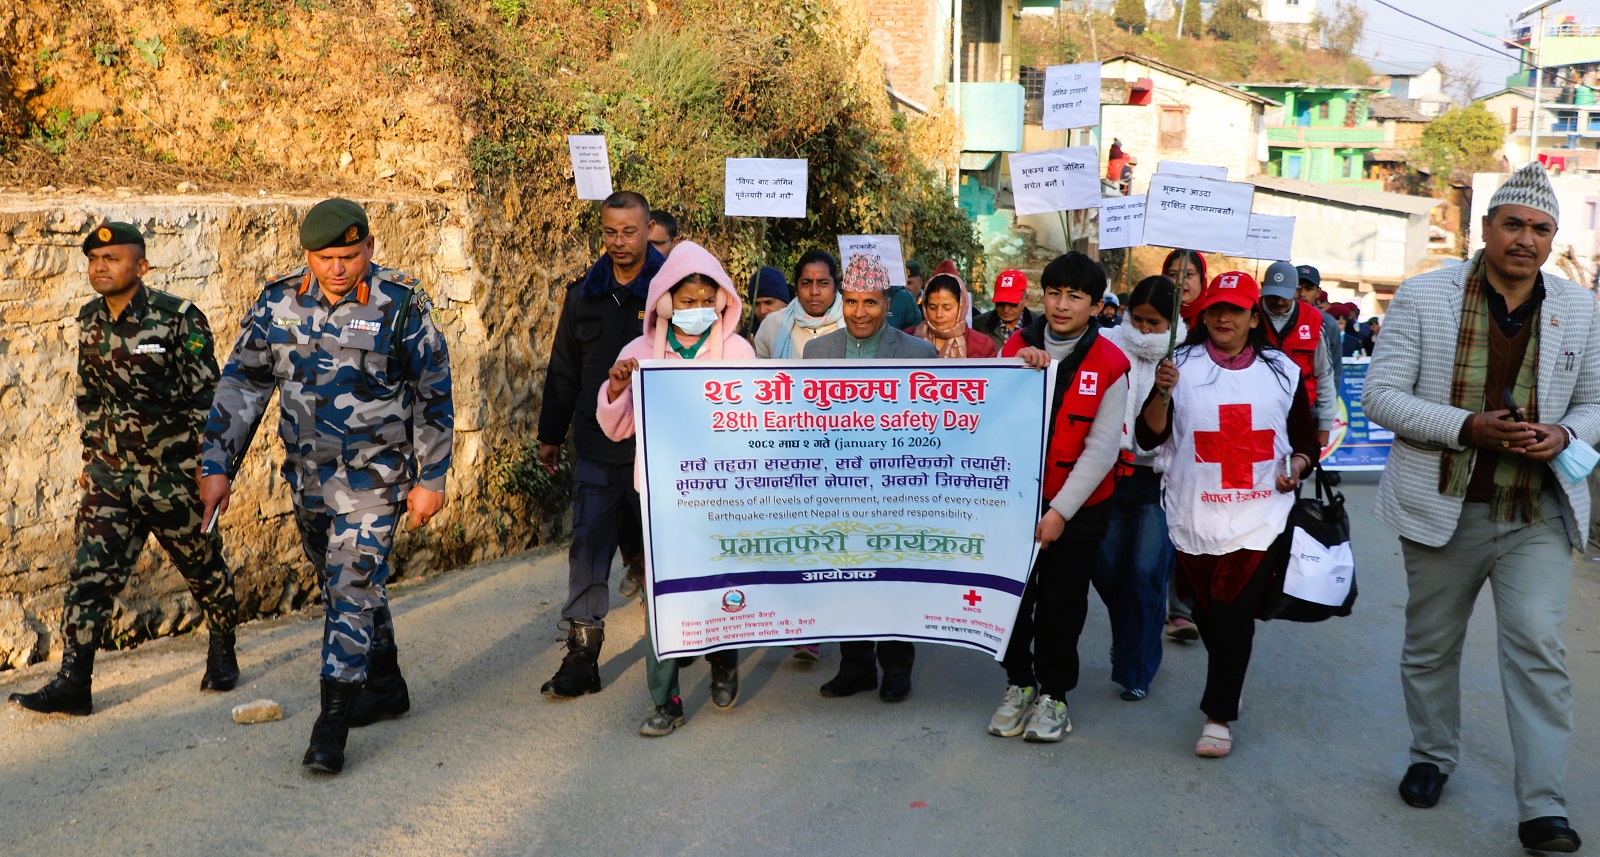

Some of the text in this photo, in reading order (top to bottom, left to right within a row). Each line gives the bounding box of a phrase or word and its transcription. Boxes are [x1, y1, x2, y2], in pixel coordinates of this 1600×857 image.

[1021, 161, 1085, 178] भूकम्प बाट जोगिन
[757, 178, 770, 186] बाट
[772, 177, 794, 186] जोगिन
[1023, 181, 1041, 190] सचेत
[735, 190, 762, 201] पूर्वतयारी
[1162, 185, 1187, 195] भूकम्प
[1160, 199, 1187, 211] सुरक्षित
[704, 379, 742, 402] २८
[803, 378, 900, 408] भुकम्प
[909, 371, 988, 403] दिवस
[712, 409, 980, 433] 28th Earthquake safety Day
[748, 436, 942, 451] २०८२ माघ २ गते (january 16 2026)
[679, 457, 707, 473] सबै
[713, 458, 759, 473] तहका
[834, 455, 864, 470] सबै
[869, 454, 955, 470] नागरिकको
[676, 477, 728, 496] भूकम्प
[734, 473, 819, 490] उत्थानशील
[881, 472, 930, 488] अबको
[935, 472, 1010, 491] जिम्मेवारी
[677, 497, 745, 509] Preparedness
[746, 496, 758, 505] of
[759, 495, 771, 505] all
[772, 495, 801, 505] levels
[803, 494, 815, 504] of
[816, 494, 880, 507] government,
[882, 493, 930, 504] readiness
[931, 493, 943, 503] of
[944, 496, 971, 506] every
[1201, 490, 1232, 503] नेपाल
[707, 510, 808, 523] Earthquake-resilient
[810, 508, 839, 520] Nepal
[841, 508, 850, 518] is
[851, 510, 869, 518] our
[871, 508, 904, 518] shared
[718, 530, 986, 557] प्रभातफेरी कार्यक्रम
[802, 568, 877, 581] आयोजक
[962, 606, 982, 614] NRCS
[681, 620, 702, 628] जिल्ला
[705, 617, 726, 626] प्रशासन
[729, 612, 755, 622] कार्यालय
[924, 614, 942, 622] नेपाल
[682, 630, 702, 638] जिल्ला
[722, 624, 742, 633] सुरक्षा
[723, 631, 755, 640] व्यवस्थापन
[941, 625, 982, 636] सरोकारवाला
